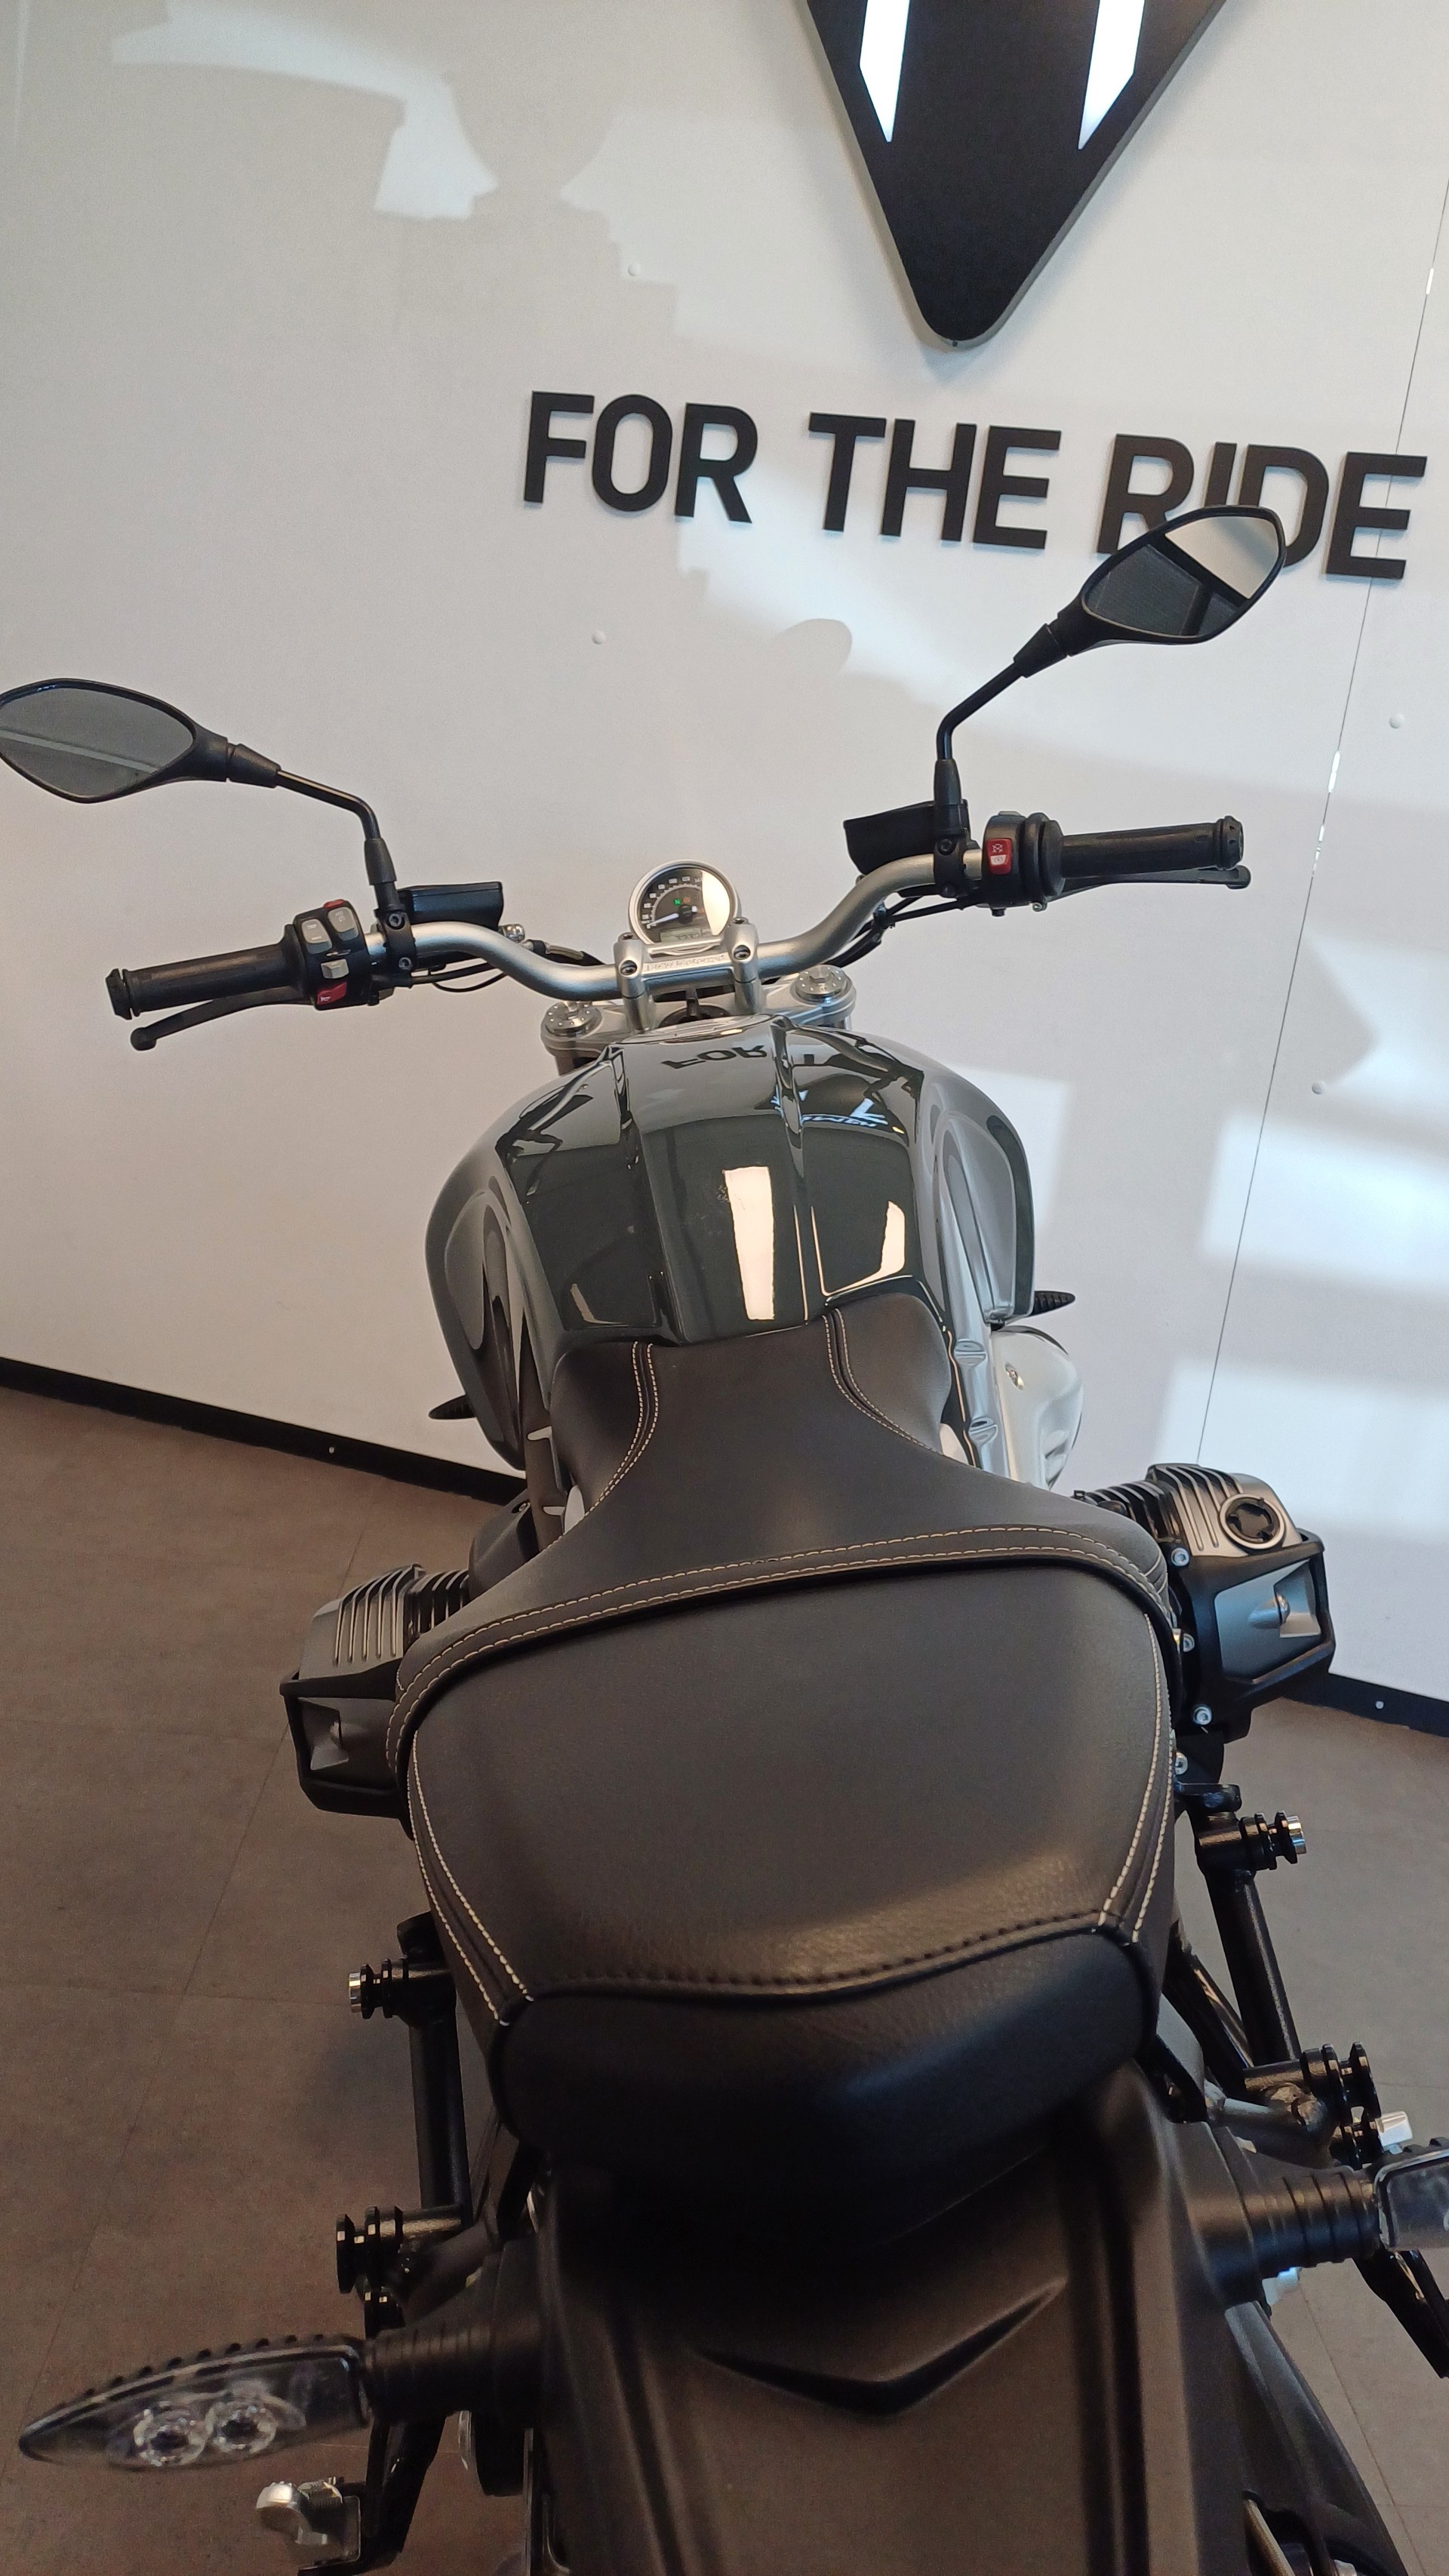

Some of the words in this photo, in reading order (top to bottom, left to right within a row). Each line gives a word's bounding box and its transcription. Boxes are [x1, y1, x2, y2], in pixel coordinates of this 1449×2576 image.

[524, 390, 759, 524] FOR
[807, 411, 1062, 551] THE
[1096, 432, 1428, 580] RIDE
